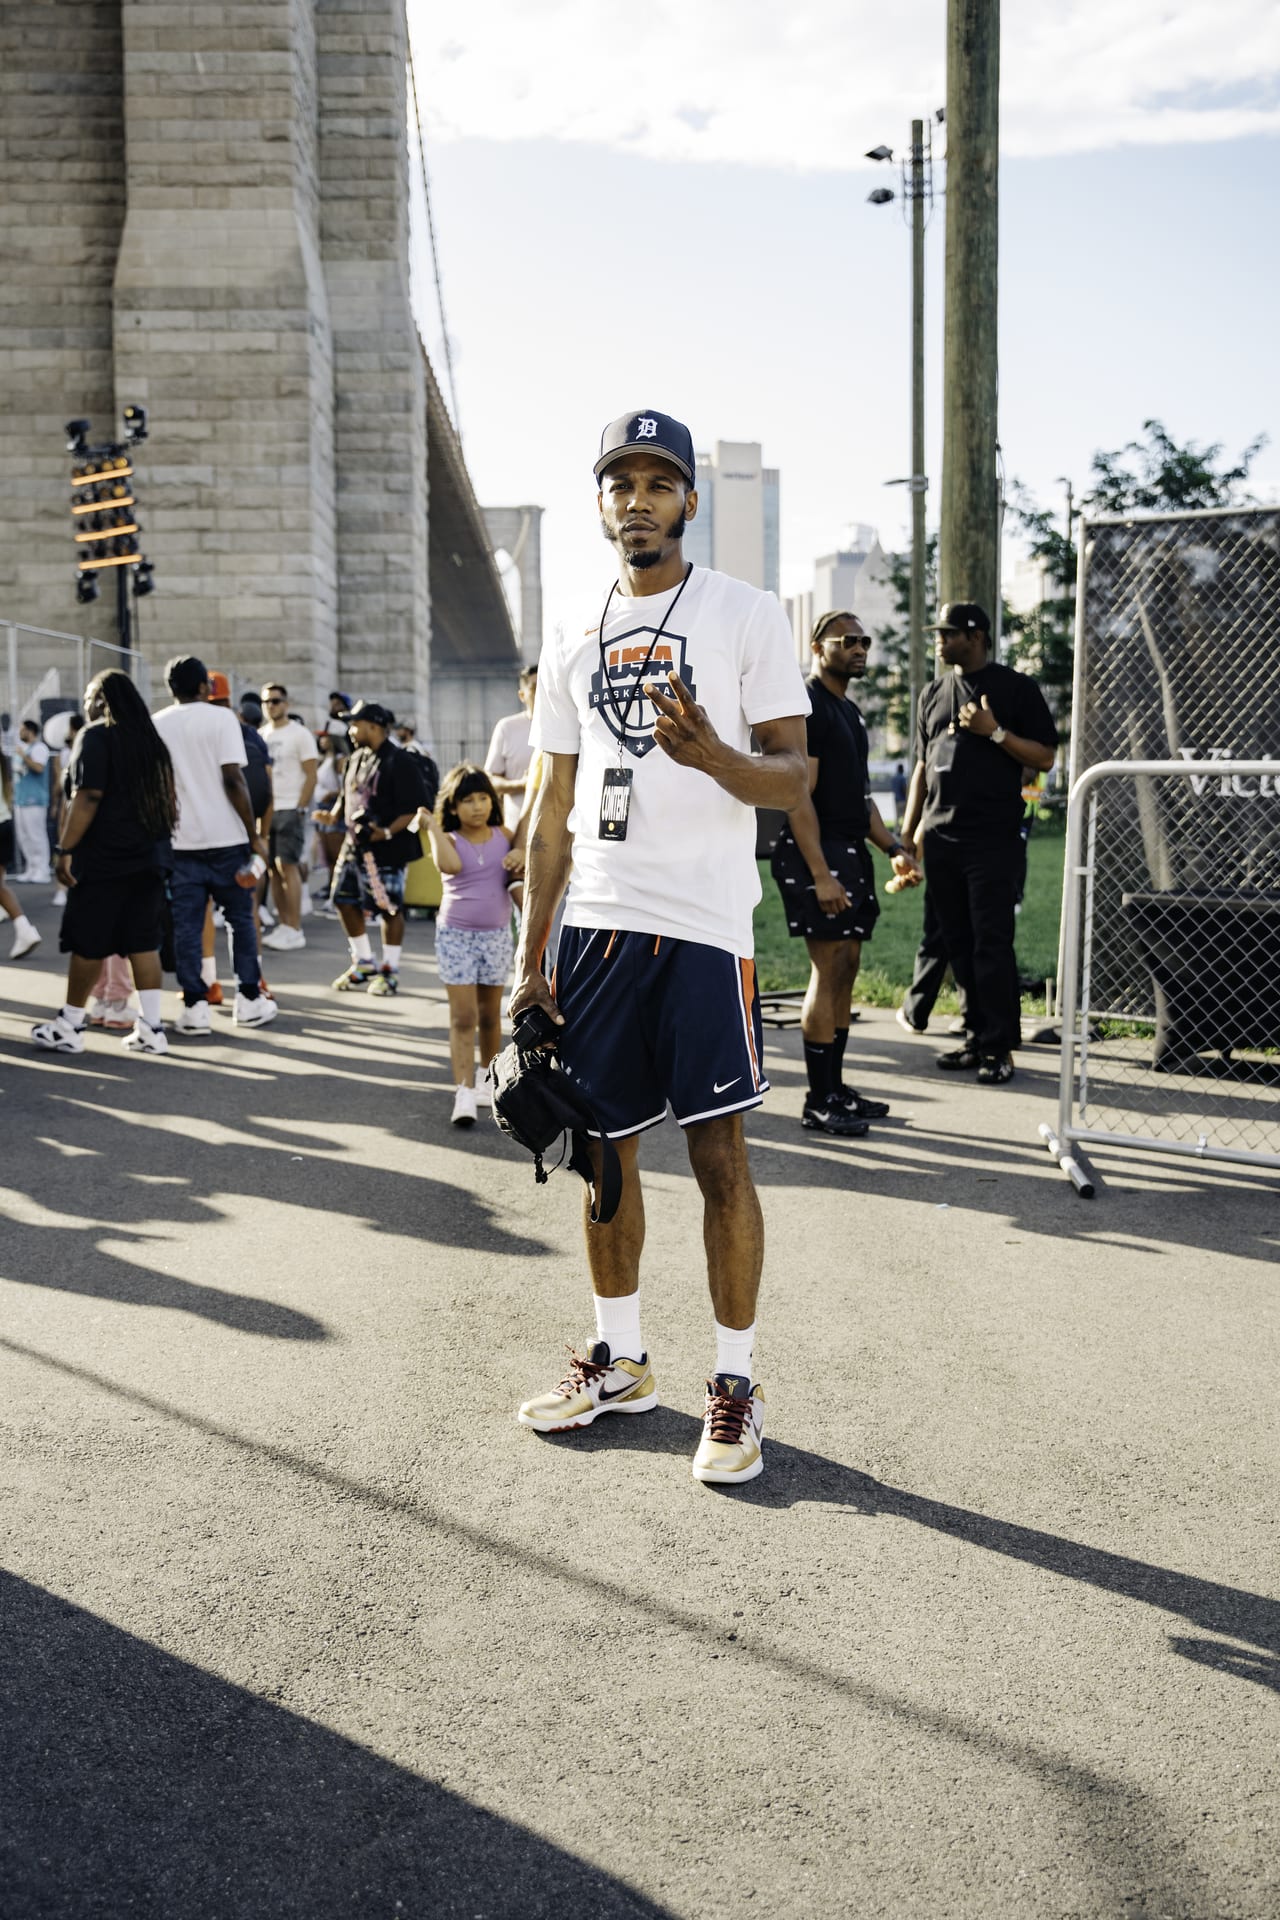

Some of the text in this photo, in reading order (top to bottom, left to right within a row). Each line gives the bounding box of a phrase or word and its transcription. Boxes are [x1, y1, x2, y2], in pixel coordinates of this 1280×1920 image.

[636, 417, 658, 440] D
[608, 645, 674, 680] USA
[593, 685, 679, 703] BASKEA
[1177, 747, 1280, 798] Vict
